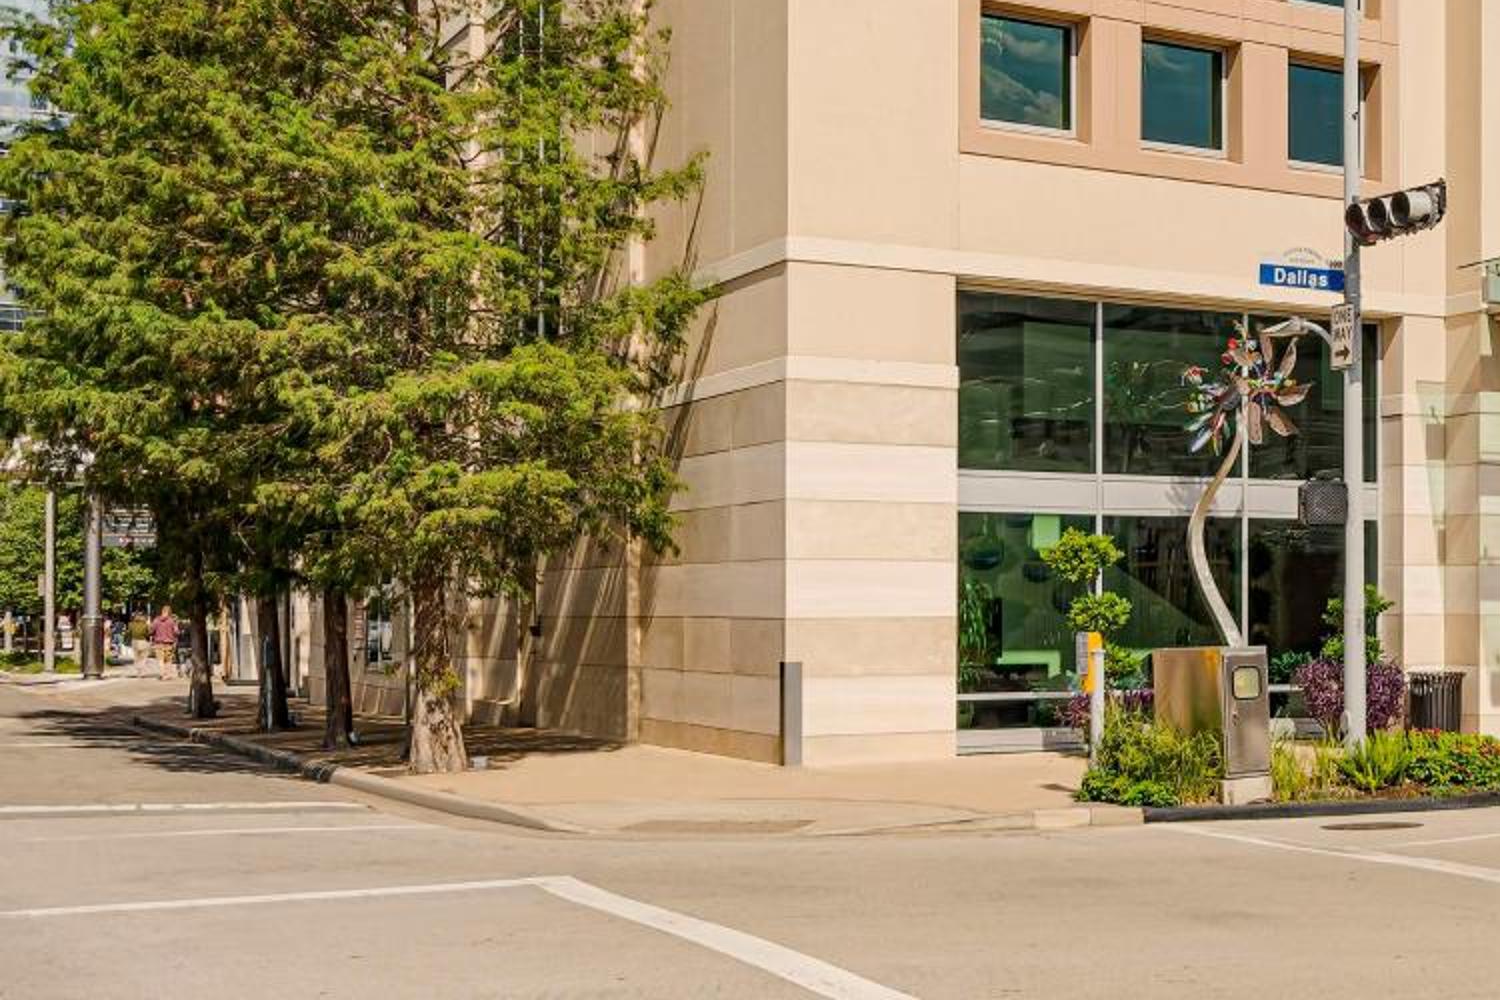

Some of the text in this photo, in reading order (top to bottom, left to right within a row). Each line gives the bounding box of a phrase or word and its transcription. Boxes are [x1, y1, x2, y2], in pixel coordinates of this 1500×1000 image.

[1274, 267, 1329, 288] Dallas
[1334, 308, 1352, 325] ONE
[1333, 325, 1353, 342] WAY
